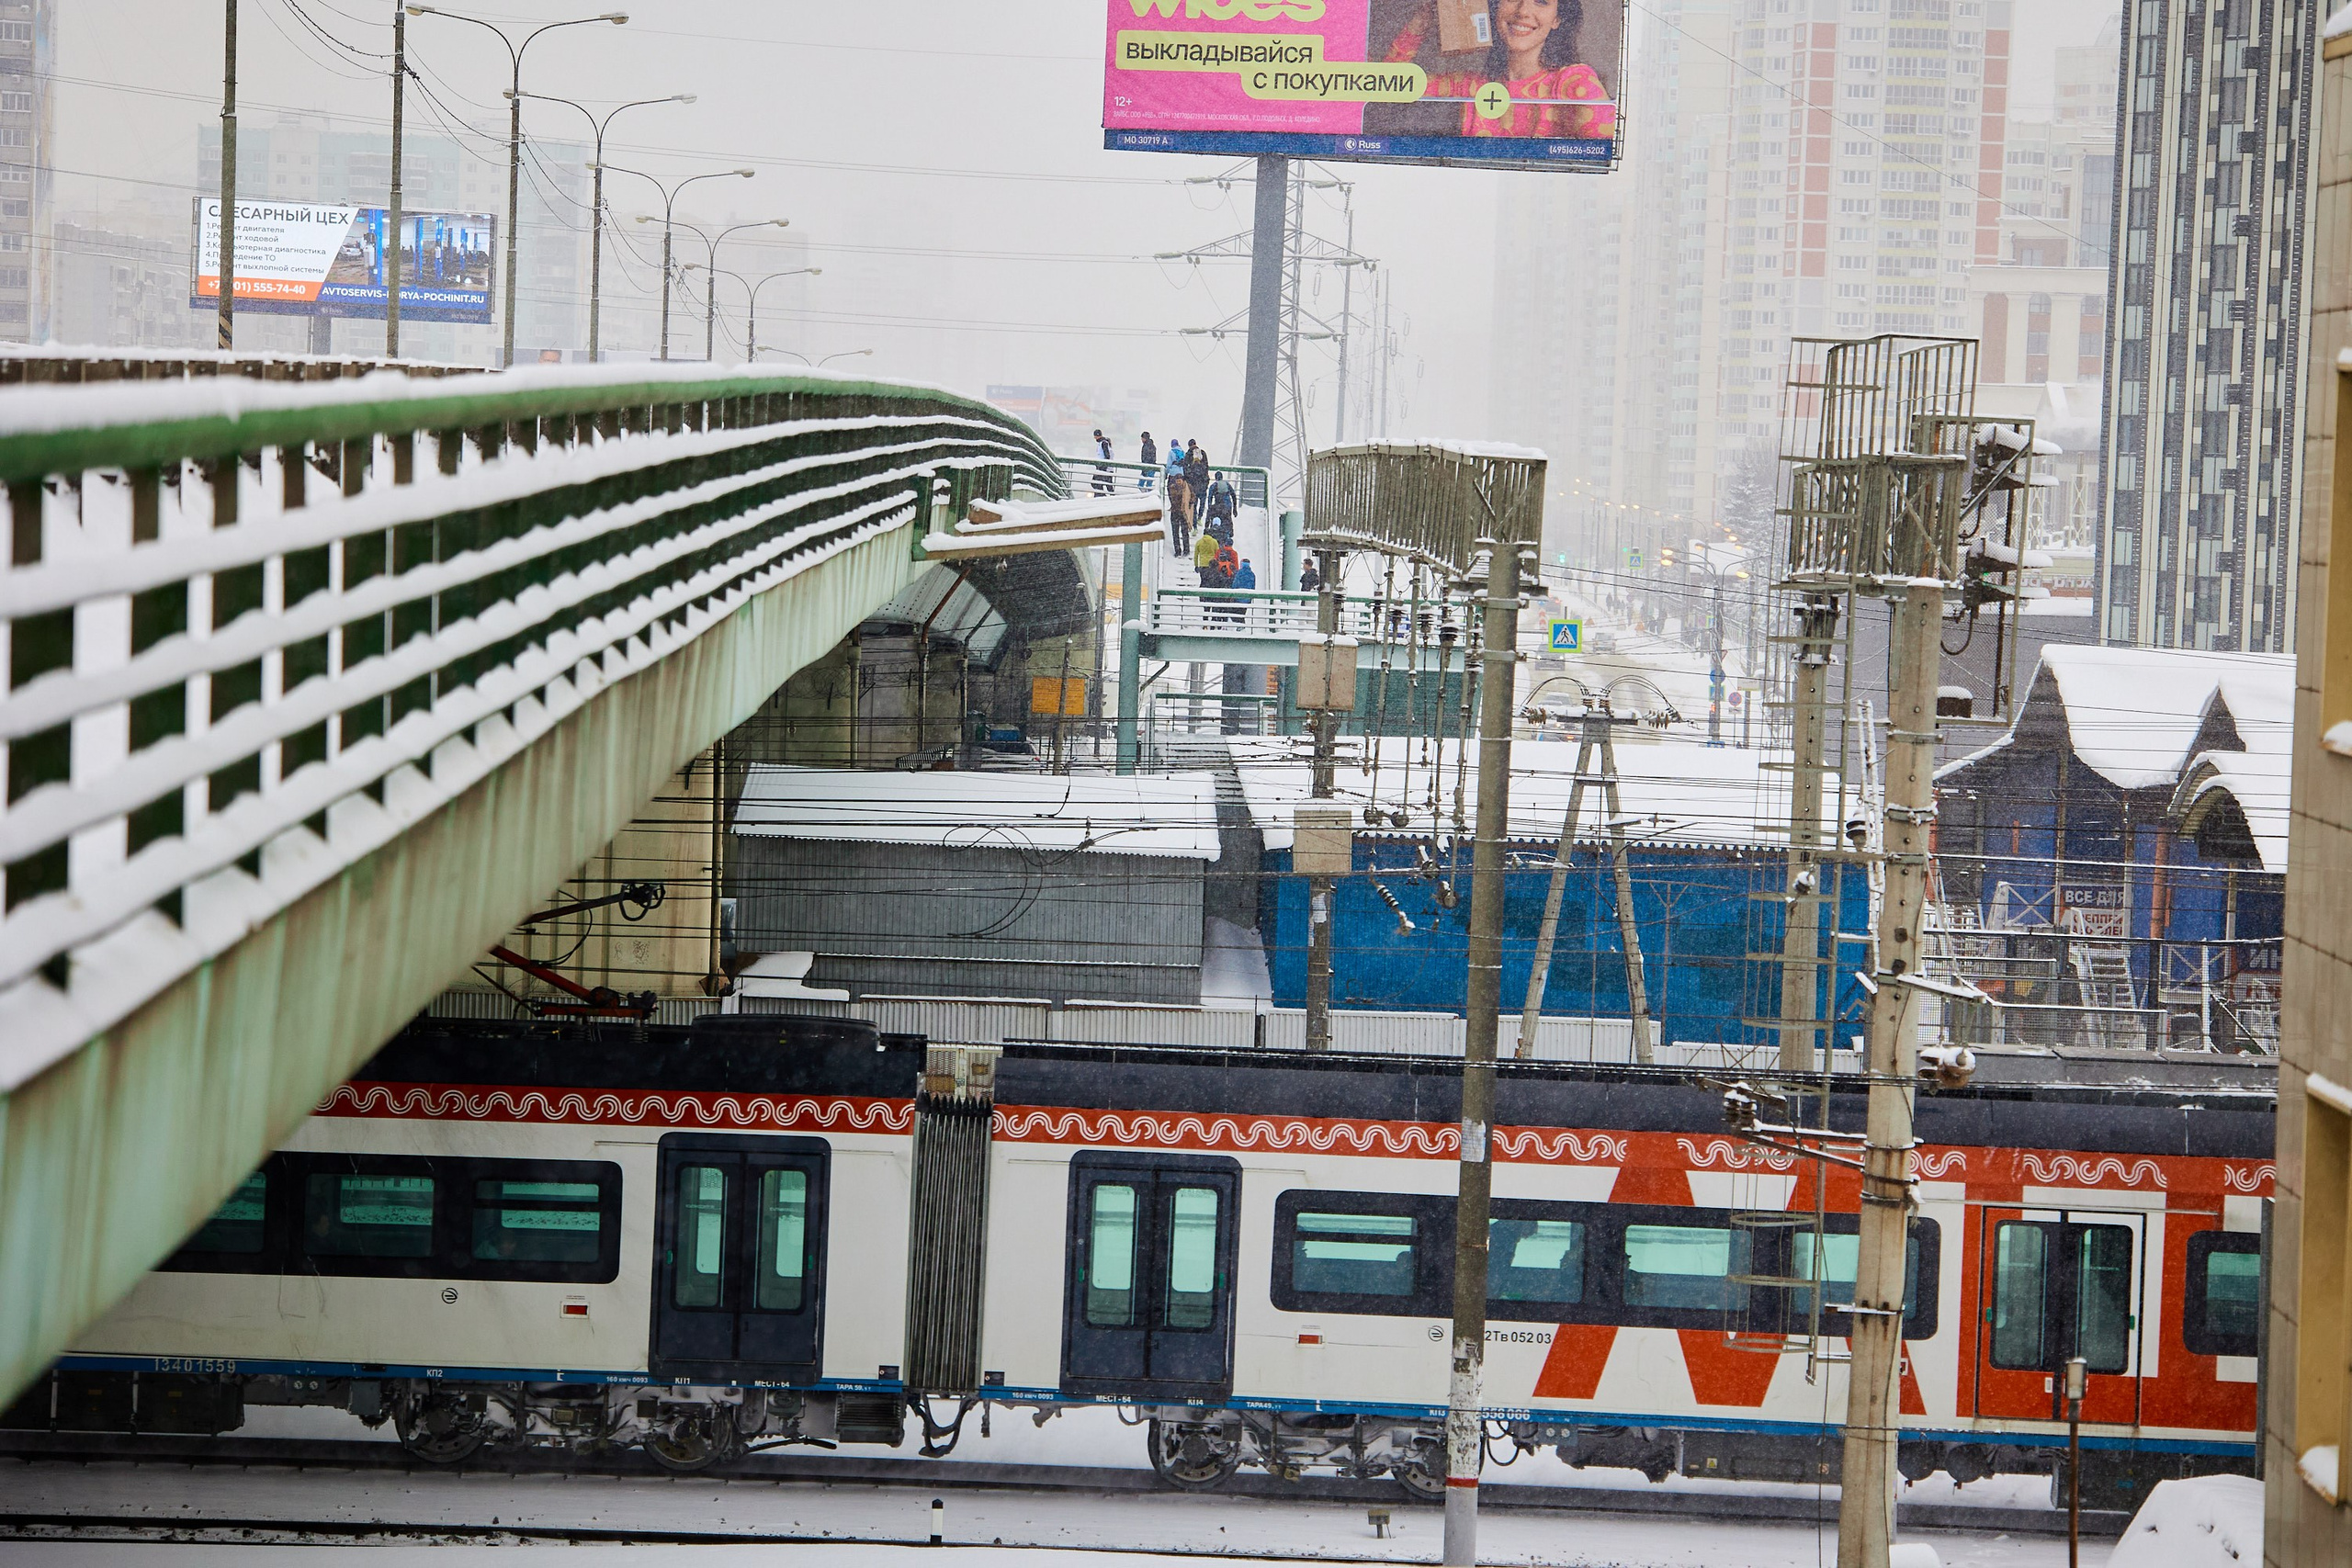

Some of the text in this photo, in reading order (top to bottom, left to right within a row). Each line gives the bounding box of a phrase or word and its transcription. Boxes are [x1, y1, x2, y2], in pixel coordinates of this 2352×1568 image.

[1126, 39, 1313, 66] выкладывайся
[1252, 72, 1414, 96] с покупками
[1114, 96, 1132, 107] 12+
[1138, 136, 1160, 144] 30719
[1358, 140, 1381, 149] Russ
[1549, 145, 1606, 154] (495)626-5202
[209, 205, 348, 226] СЕСАРНЫЙ ЦЕХ
[242, 226, 285, 234] двигателя
[243, 235, 279, 243] ходовой
[274, 247, 326, 256] диагностика
[243, 265, 288, 273] выхлопной
[253, 282, 306, 295] 555-74-40
[322, 287, 485, 304] AVTOSERVIS-RYA-POCHINIT.RU
[2064, 890, 2124, 907] ВСЕ ДЛЯ
[1510, 1331, 1534, 1343] 052
[1536, 1333, 1552, 1344] 03
[154, 1358, 236, 1373] 13401559
[426, 1369, 443, 1378] КП2
